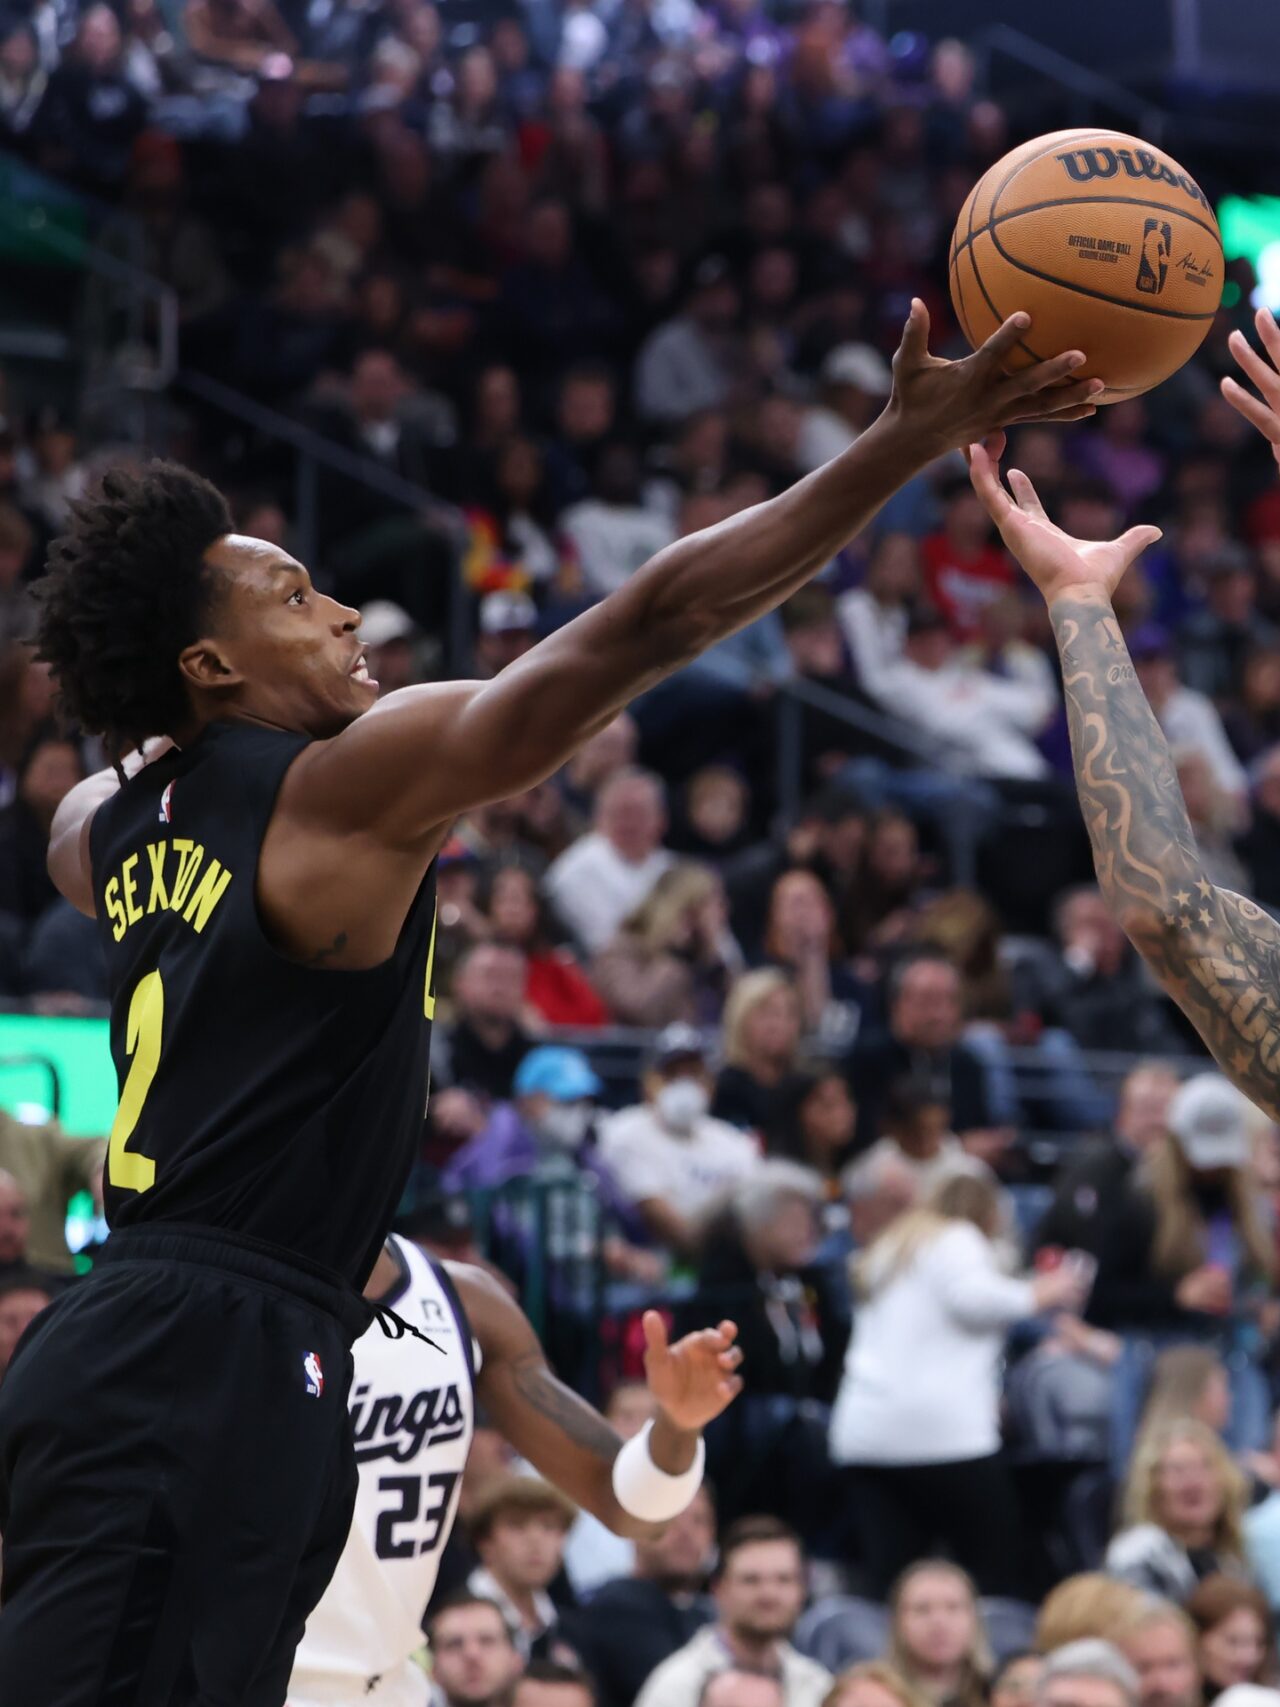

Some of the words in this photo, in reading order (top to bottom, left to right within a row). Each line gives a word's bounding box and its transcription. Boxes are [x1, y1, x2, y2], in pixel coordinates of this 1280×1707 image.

[1068, 235, 1097, 250] OFFICIAL
[1116, 242, 1132, 256] BALL
[105, 838, 232, 942] SEXTON
[108, 968, 164, 1194] 2
[353, 1384, 463, 1463] ings
[375, 1471, 463, 1560] 23
